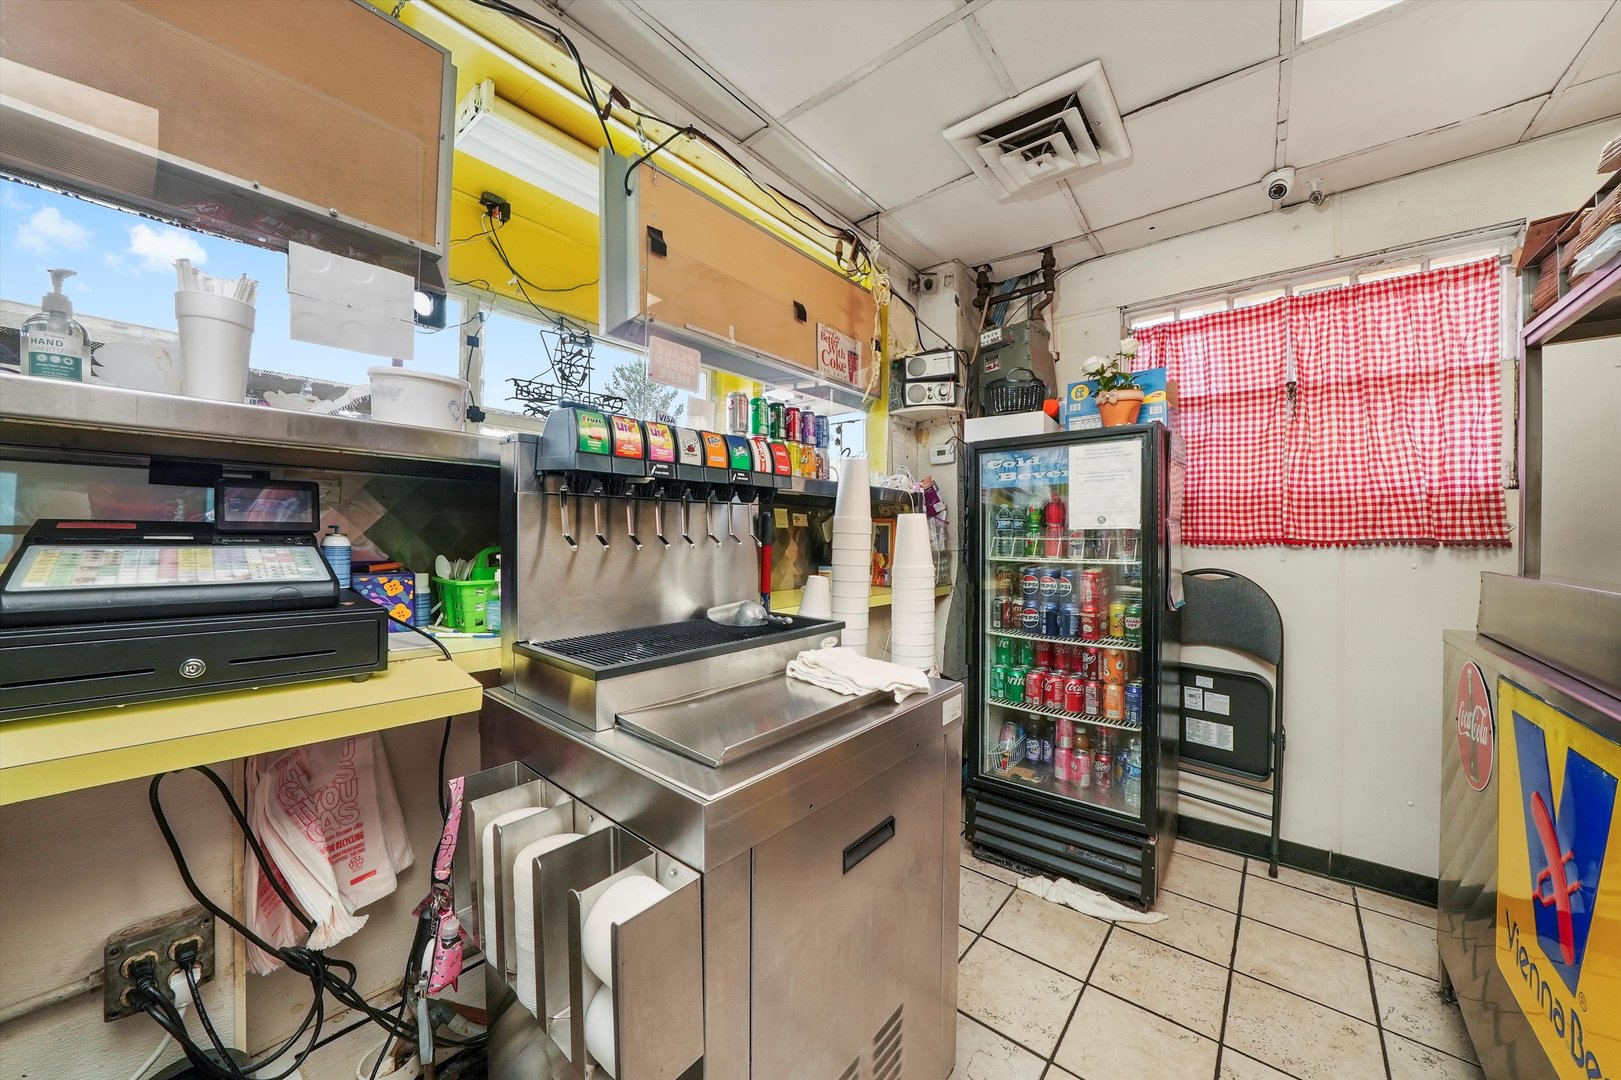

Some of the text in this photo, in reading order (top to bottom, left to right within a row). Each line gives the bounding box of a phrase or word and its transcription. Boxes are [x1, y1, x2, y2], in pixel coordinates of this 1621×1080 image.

[30, 337, 64, 347] HAND
[30, 345, 77, 356] SANITIZER
[821, 349, 847, 373] Coke
[659, 414, 676, 424] VISA
[986, 455, 1041, 469] Cold
[1505, 907, 1611, 1080] Vienna Be
